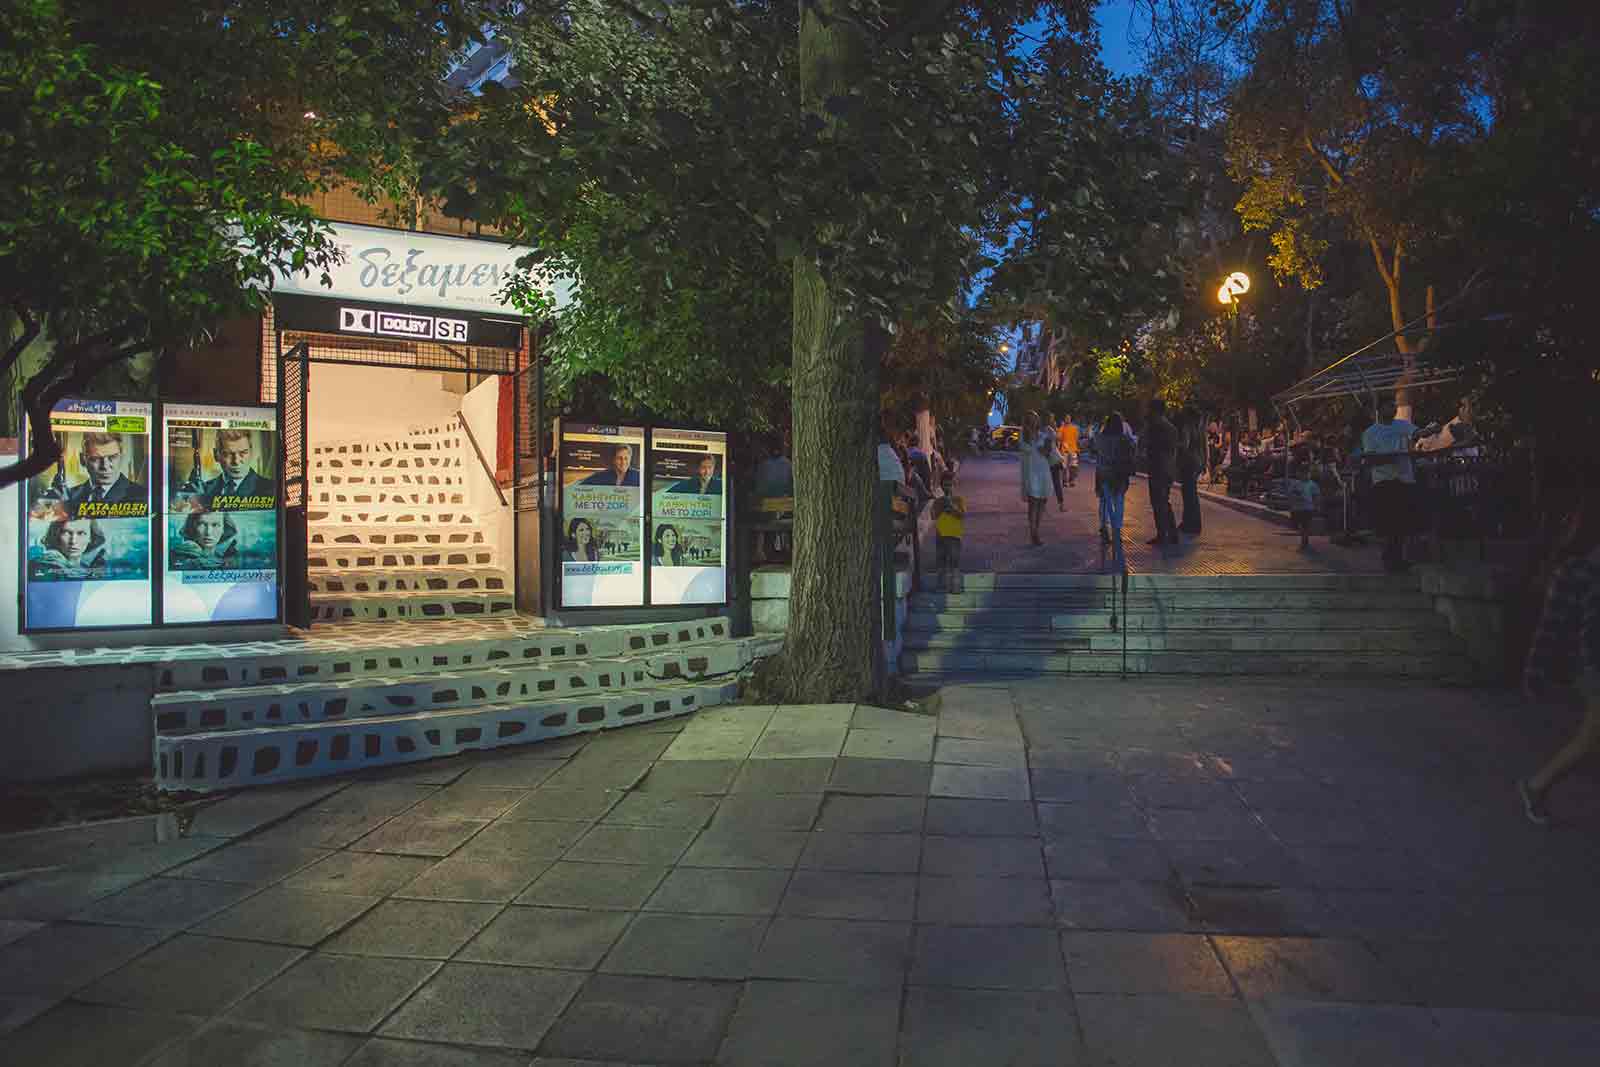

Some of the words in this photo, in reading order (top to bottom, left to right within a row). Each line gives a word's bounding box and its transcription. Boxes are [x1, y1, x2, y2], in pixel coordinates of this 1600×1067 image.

[359, 247, 513, 297] δεξαμεν
[383, 317, 428, 333] DOLBY
[438, 321, 466, 339] SR
